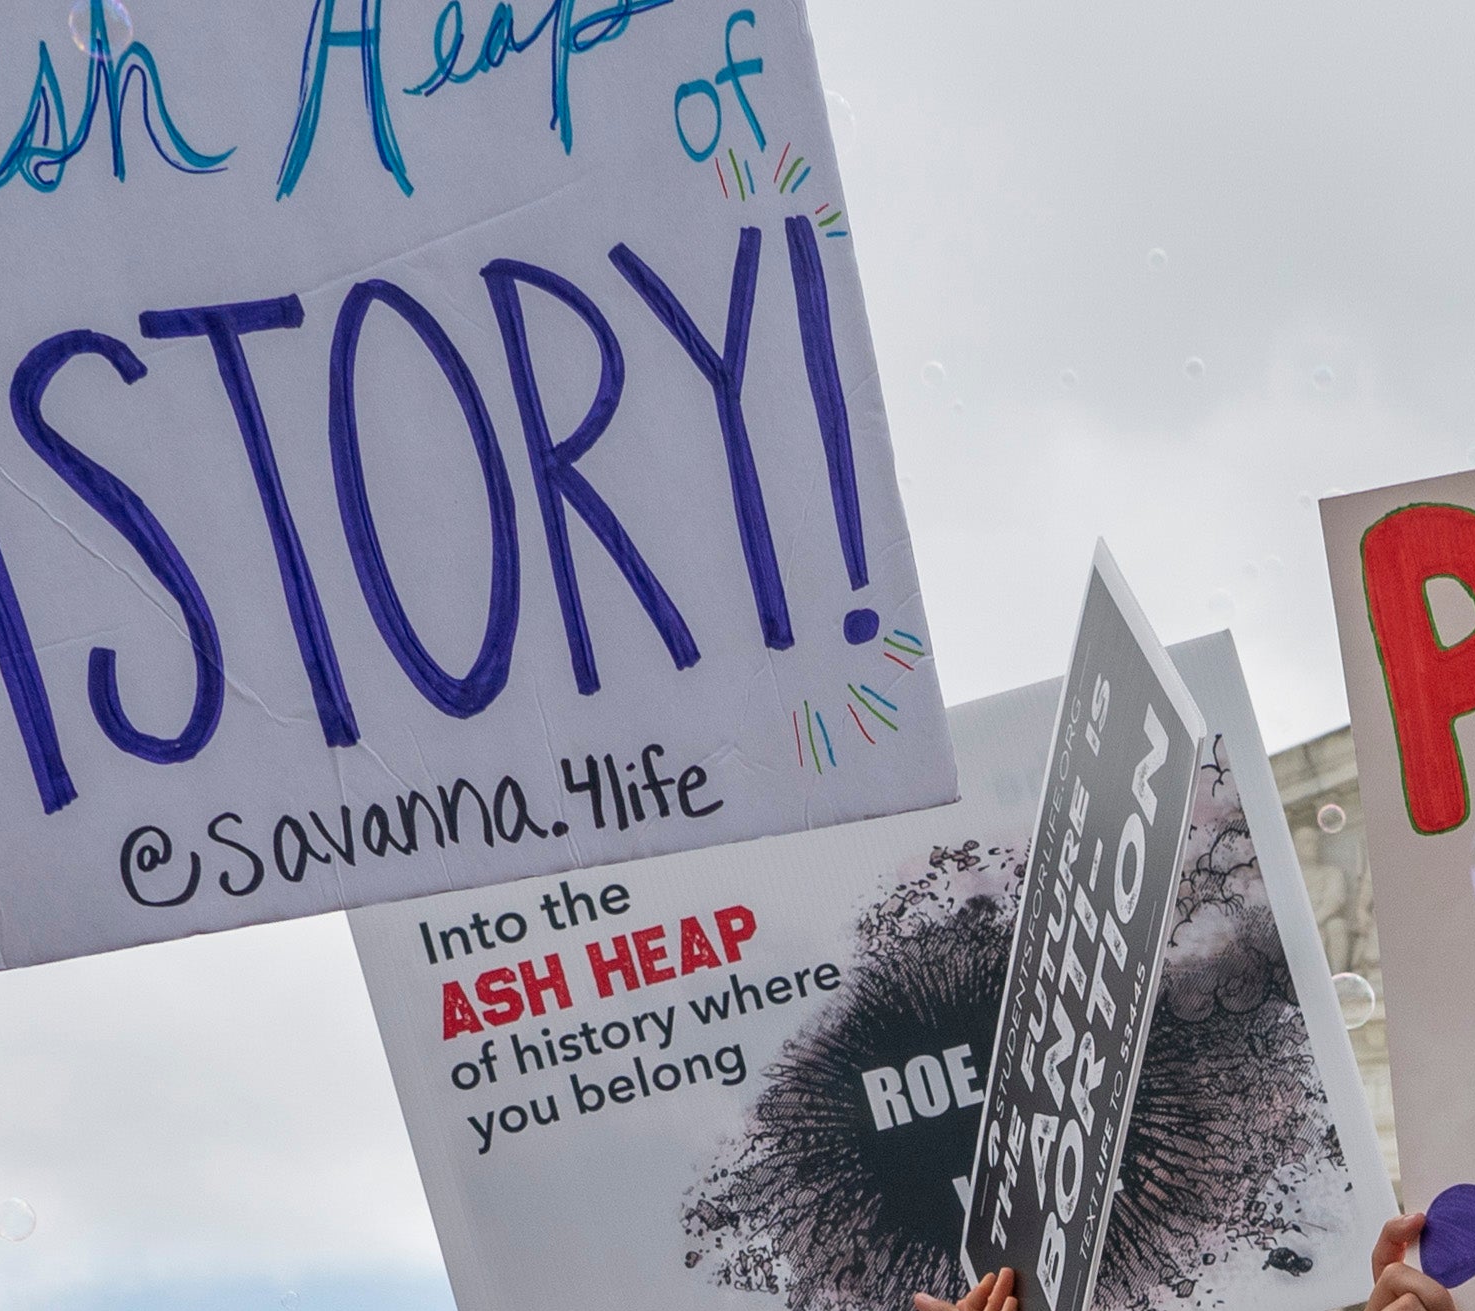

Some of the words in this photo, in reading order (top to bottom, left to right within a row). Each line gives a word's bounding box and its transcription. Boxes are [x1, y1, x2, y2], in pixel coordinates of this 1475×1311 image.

[674, 10, 767, 163] of
[118, 744, 726, 910] @savanna.4life
[419, 910, 528, 965] Into
[540, 880, 632, 931] the
[442, 953, 574, 1041] ASH
[585, 905, 757, 999] HEAP
[989, 1104, 1026, 1250] THE
[1021, 775, 1090, 1092] FUTURE
[1084, 672, 1111, 757] IS
[995, 696, 1083, 1120] STUDENTSFORLIFE.ORG
[451, 1040, 499, 1091] of
[510, 1005, 675, 1076] history
[688, 962, 842, 1026] where
[467, 1094, 560, 1155] you
[570, 1043, 747, 1115] belong
[861, 1042, 985, 1130] ROE
[1027, 837, 1104, 1210] ANTI-
[1079, 1187, 1099, 1260] TEXT
[1095, 1117, 1115, 1187] LIFE
[1109, 1070, 1124, 1111] TO
[1120, 961, 1146, 1064] 53445
